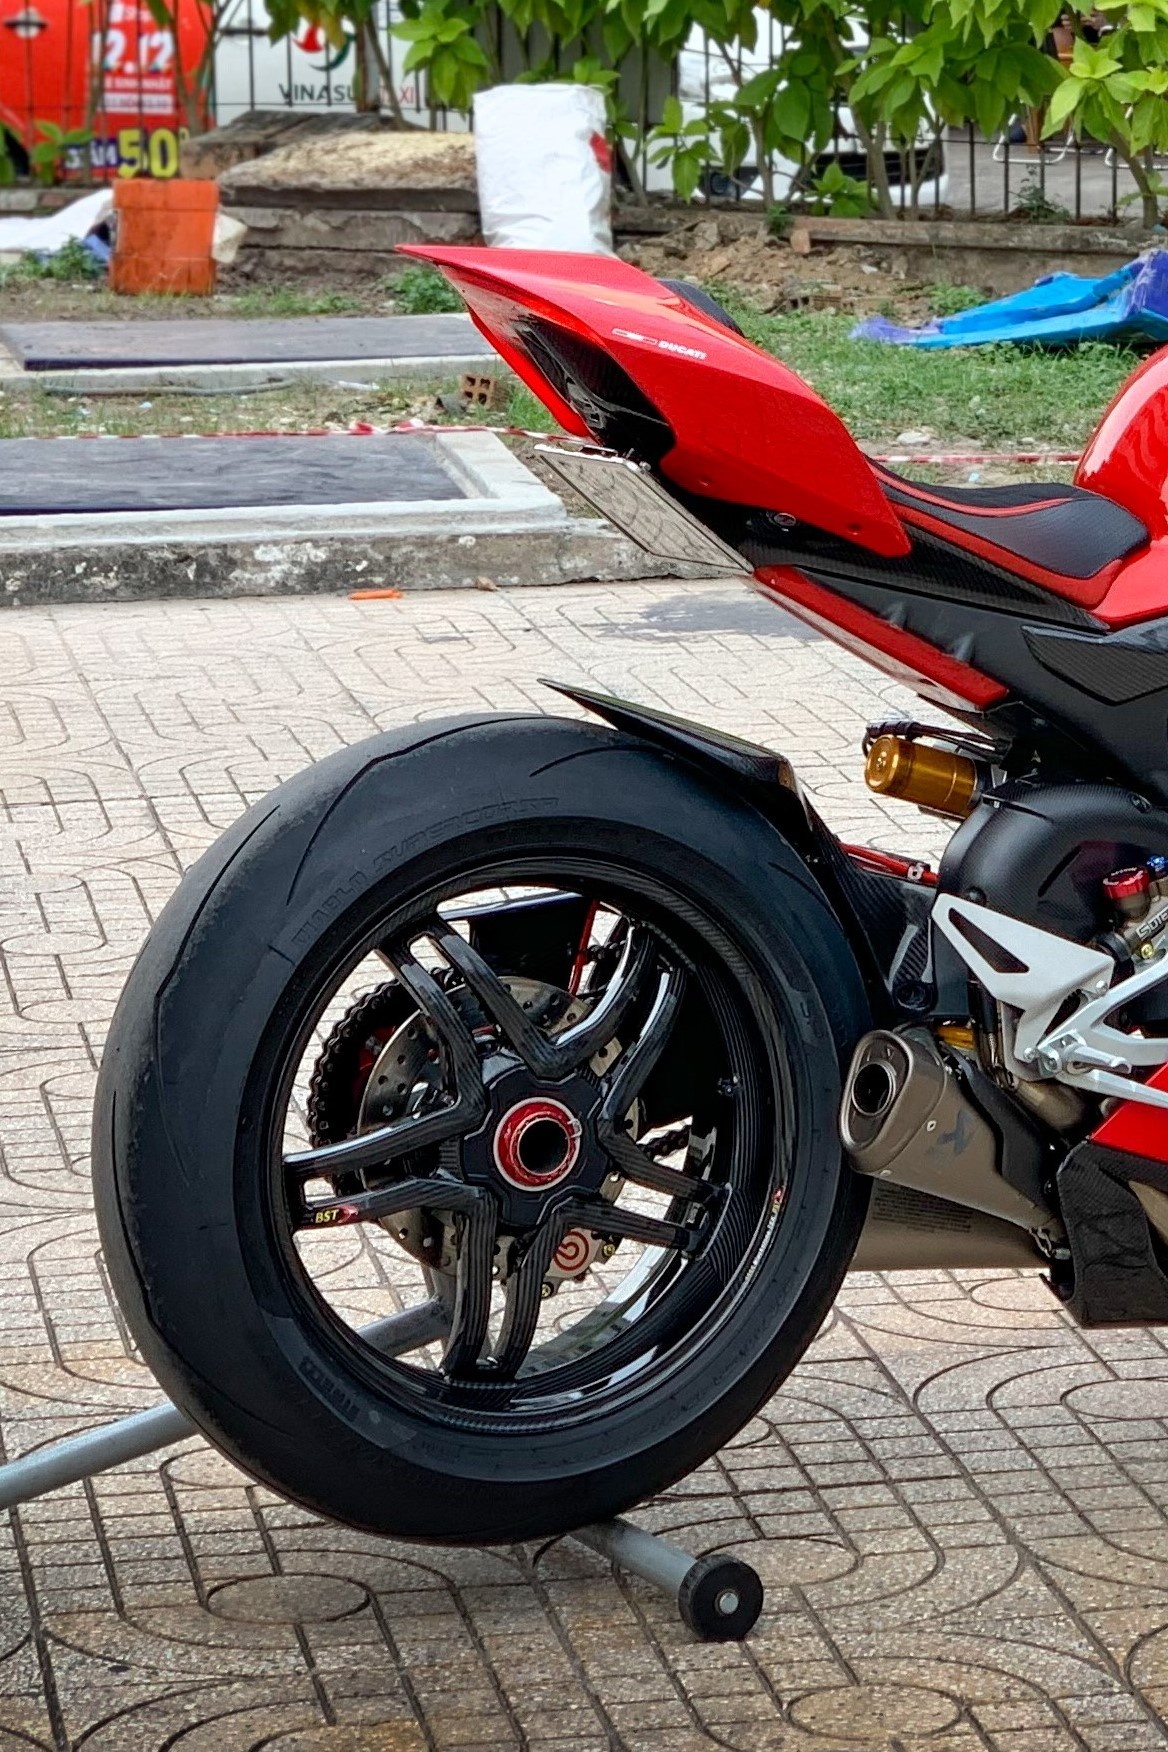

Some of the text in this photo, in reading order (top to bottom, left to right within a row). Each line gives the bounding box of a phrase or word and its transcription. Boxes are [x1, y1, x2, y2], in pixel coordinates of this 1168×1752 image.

[278, 83, 358, 101] VINASU
[658, 340, 707, 360] DUCATI
[315, 1209, 340, 1224] BST
